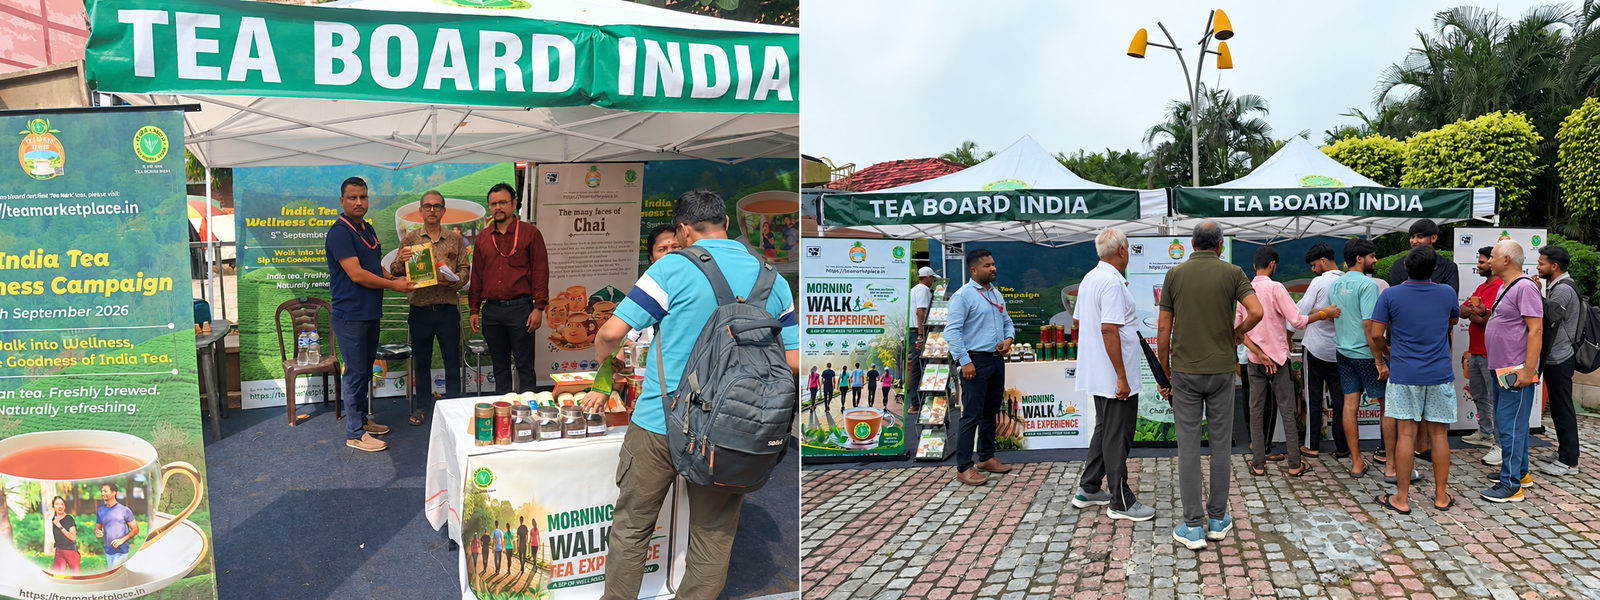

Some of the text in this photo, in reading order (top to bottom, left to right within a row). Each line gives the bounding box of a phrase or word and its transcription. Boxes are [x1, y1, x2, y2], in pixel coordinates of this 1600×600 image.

[117, 9, 794, 102] TEA BOARD INDIA
[869, 195, 1089, 218] TEA BOARD INDIA
[1219, 192, 1424, 212] TEA BOARD INDIA
[281, 206, 338, 216] India Tea
[559, 208, 571, 216] The
[574, 208, 593, 217] many
[614, 207, 621, 215] of
[245, 217, 306, 228] Wellness
[574, 217, 606, 232] Chai
[0, 248, 110, 270] India Tea
[51, 271, 173, 298] Campaign
[806, 283, 853, 294] MORNING
[806, 296, 852, 312] WALK
[12, 305, 92, 321] September
[95, 305, 129, 317] 2026
[806, 315, 886, 326] TEA EXPERIENCE
[0, 335, 134, 351] alk into Wellness,
[7, 355, 77, 368] Goodness
[82, 353, 95, 365] of
[99, 353, 138, 365] India
[141, 352, 172, 364] Tea.
[20, 387, 45, 399] tea.
[50, 386, 101, 399] Freshly
[105, 384, 160, 397] brewed.
[1021, 393, 1055, 404] MORNING
[64, 400, 139, 415] refreshing.
[1022, 404, 1055, 419] WALK
[1023, 418, 1079, 430] TEA EXPERIENCE
[547, 503, 615, 532] MORNING
[549, 525, 612, 561] WALK
[547, 561, 574, 579] TEA
